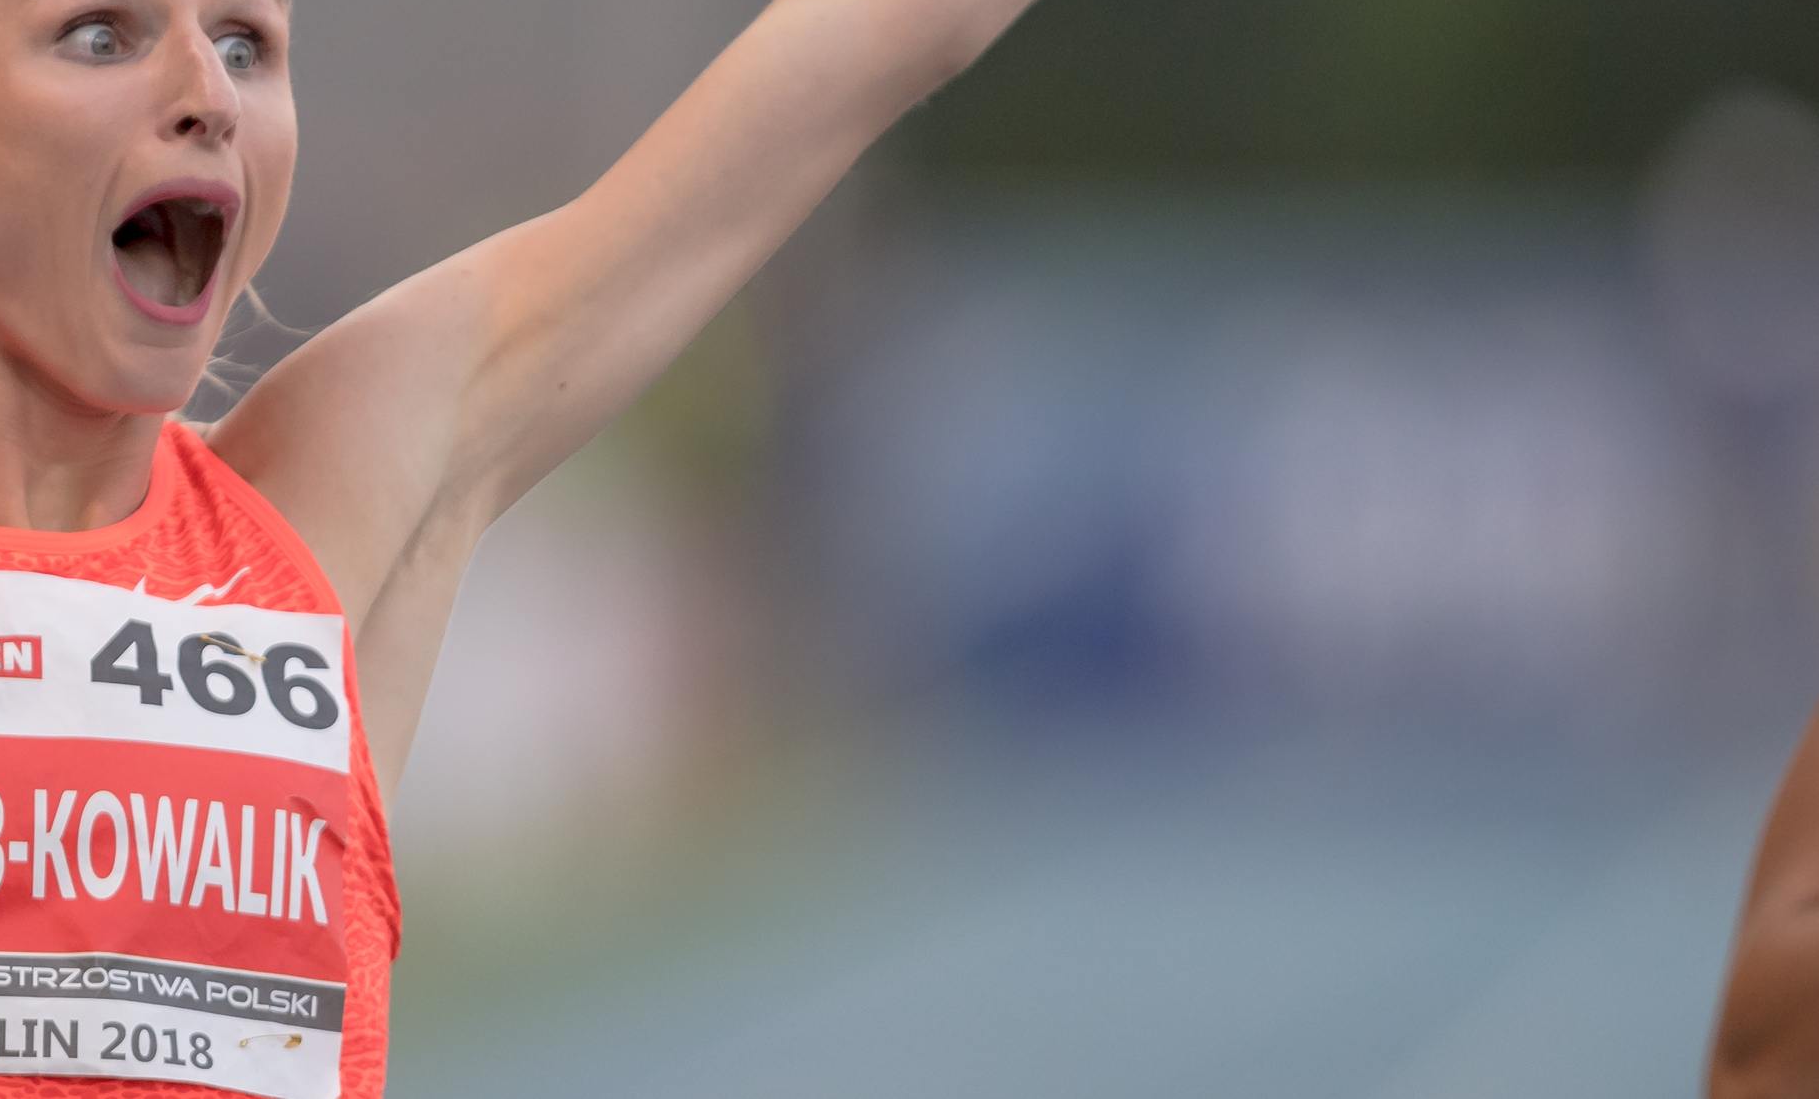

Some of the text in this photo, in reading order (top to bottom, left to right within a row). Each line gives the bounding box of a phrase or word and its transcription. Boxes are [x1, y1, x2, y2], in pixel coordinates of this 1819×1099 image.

[90, 617, 339, 730] 466
[206, 984, 318, 1018] POLSKI
[100, 1020, 214, 1071] 2018
